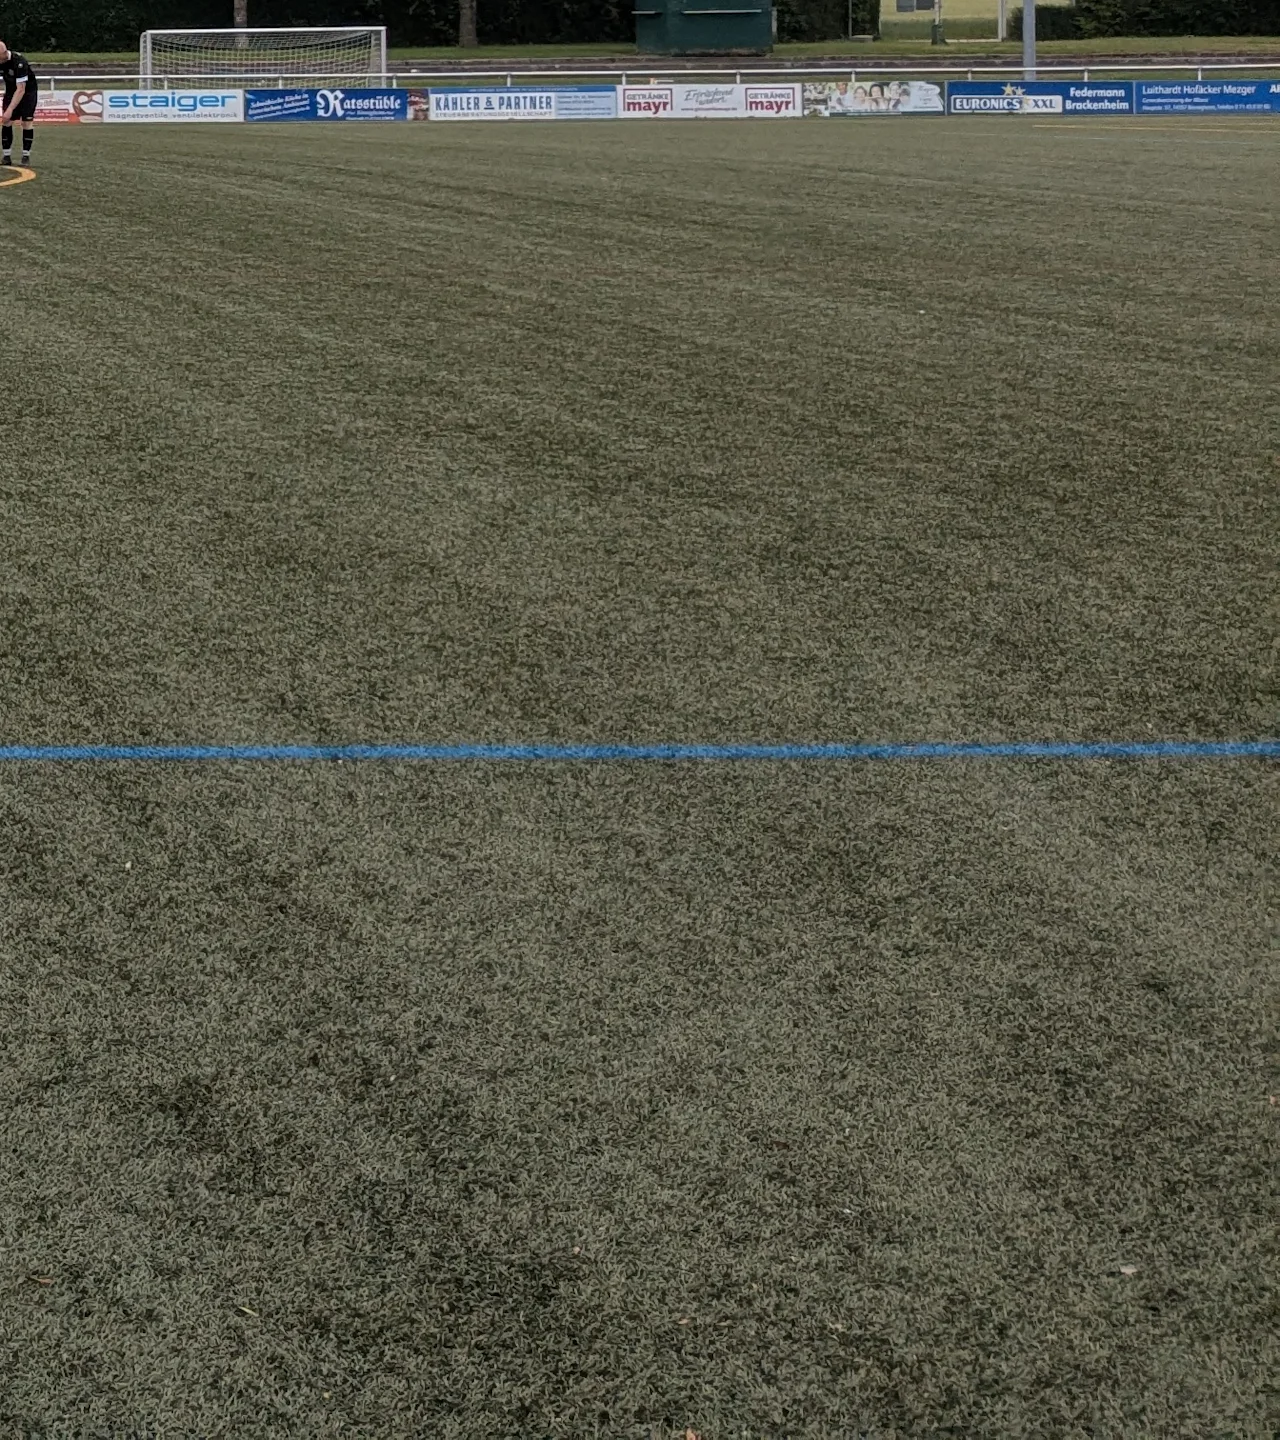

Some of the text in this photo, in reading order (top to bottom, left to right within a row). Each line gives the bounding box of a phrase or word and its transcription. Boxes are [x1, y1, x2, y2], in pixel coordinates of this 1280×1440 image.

[626, 92, 669, 100] GETRÄNKE
[749, 92, 791, 100] GETRÄNKE
[1070, 87, 1125, 97] Federmann
[1142, 85, 1181, 95] Luithardt
[1223, 85, 1256, 96] Mezger
[108, 92, 237, 112] staiger
[316, 90, 401, 117] Ratsstüble
[435, 94, 480, 111] KÄHLER
[498, 95, 552, 110] PARTNER
[626, 101, 669, 114] mayr
[749, 100, 791, 114] mayr
[955, 97, 1056, 110] EURONICS XXL
[1065, 100, 1129, 111] Brackenheim
